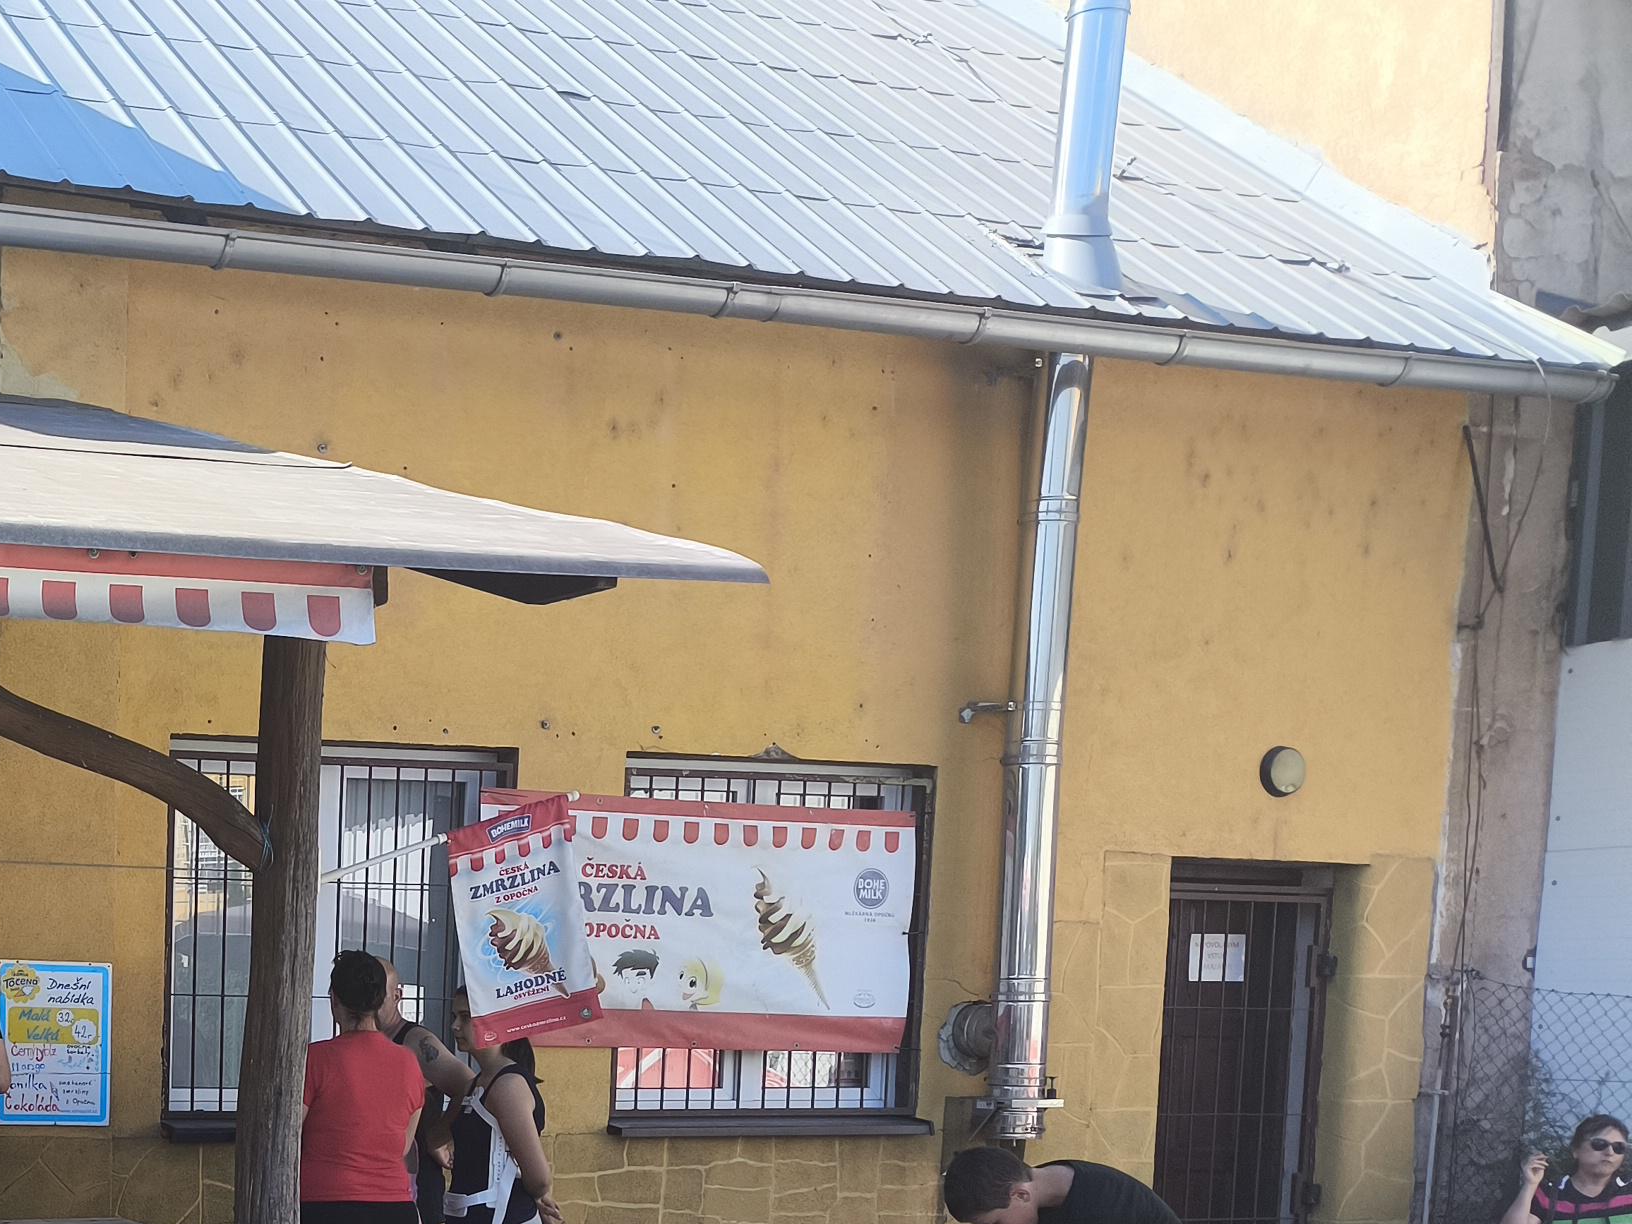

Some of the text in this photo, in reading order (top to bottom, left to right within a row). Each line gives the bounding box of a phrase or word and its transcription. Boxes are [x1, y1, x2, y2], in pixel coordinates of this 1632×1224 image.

[490, 817, 529, 838] BOHEMILK
[499, 861, 529, 876] ČESKÁ
[581, 857, 646, 880] ČESKÁ
[469, 860, 560, 900] ZMRZLINA
[858, 878, 885, 889] BOHE
[503, 885, 538, 901] OPOČNA
[578, 881, 714, 917] RZLINA
[859, 889, 883, 899] MILK
[47, 977, 91, 990] Dnešní
[495, 967, 566, 998] LAHODNÉ
[48, 992, 94, 1006] nabídka
[18, 1008, 51, 1022] Malá
[26, 1025, 60, 1041] Velká
[10, 1073, 47, 1091] anilka
[5, 1092, 60, 1112] Čokoláda
